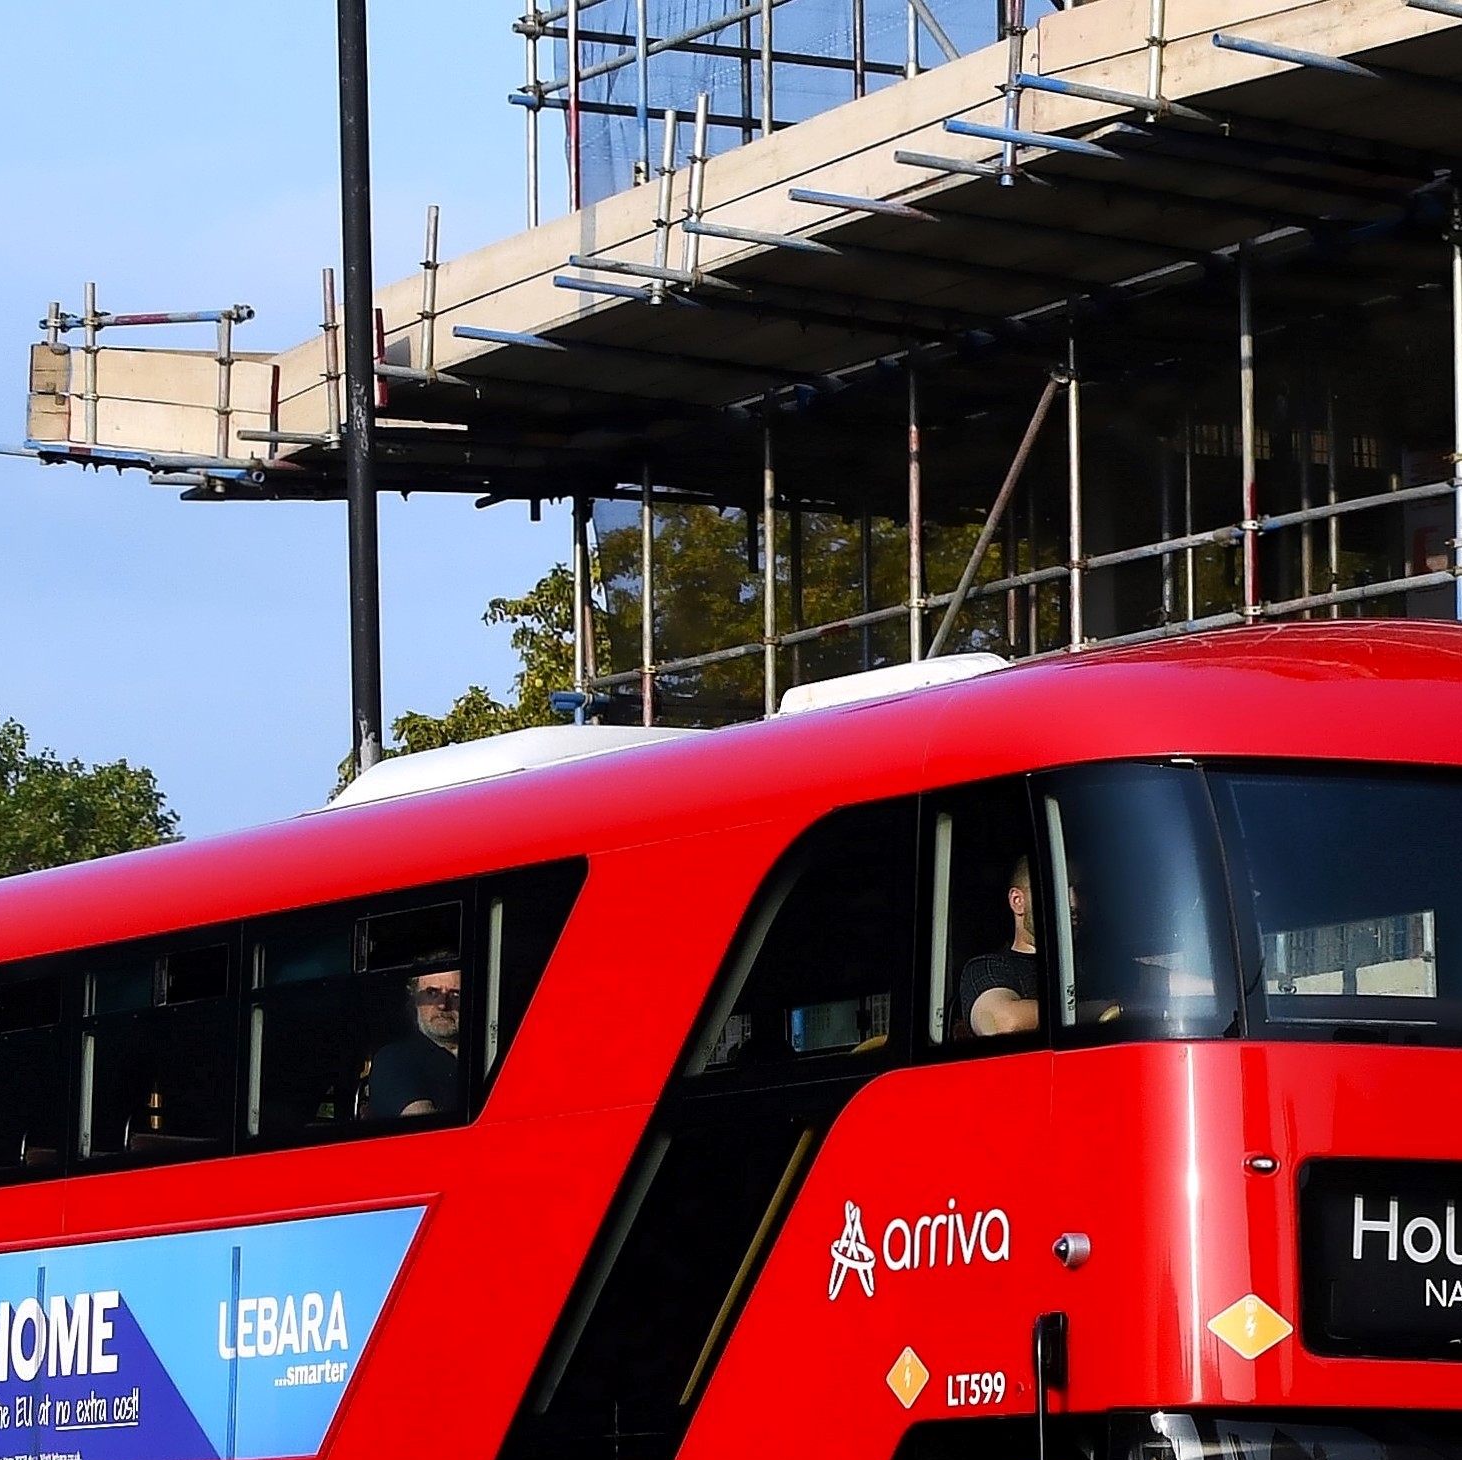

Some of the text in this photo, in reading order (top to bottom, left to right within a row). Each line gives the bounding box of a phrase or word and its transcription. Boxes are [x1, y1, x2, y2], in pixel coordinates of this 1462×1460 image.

[883, 1198, 1010, 1271] arriva
[219, 1290, 349, 1360] LEBARA
[16, 1396, 33, 1427] EU
[38, 1393, 51, 1426] at
[56, 1401, 71, 1425] no
[76, 1390, 106, 1424] extra
[947, 1371, 1006, 1407] LT599
